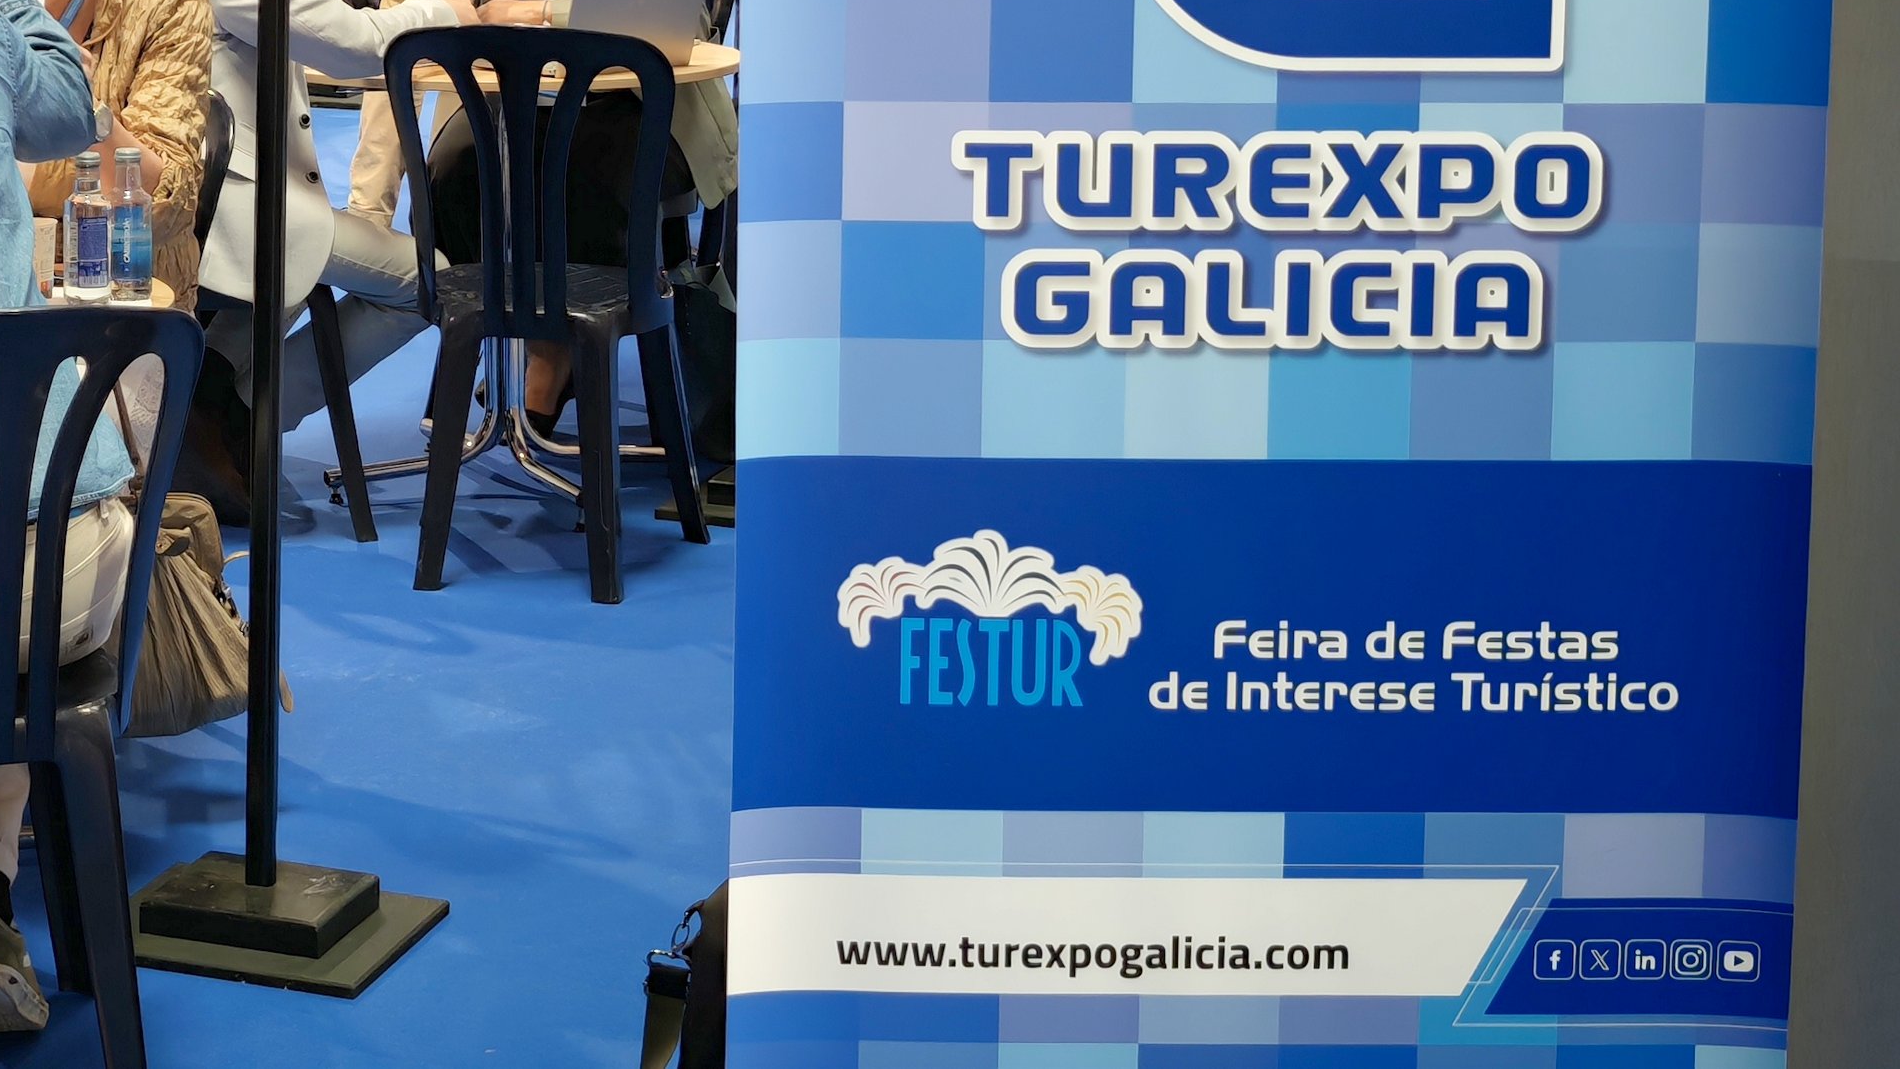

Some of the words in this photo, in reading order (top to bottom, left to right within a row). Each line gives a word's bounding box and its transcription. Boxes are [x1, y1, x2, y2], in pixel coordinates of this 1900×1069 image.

[955, 133, 1600, 229] TUREXPO
[1004, 252, 1541, 346] GALICIA
[900, 617, 1083, 707] FESTUR
[1214, 620, 1347, 659] Feira
[1365, 621, 1425, 659] de
[1442, 621, 1619, 660] Festas
[1148, 671, 1208, 711] de
[1226, 671, 1435, 711] Interese
[1451, 671, 1679, 712] Turístico
[835, 934, 1349, 979] www.turexpogalicia.com
